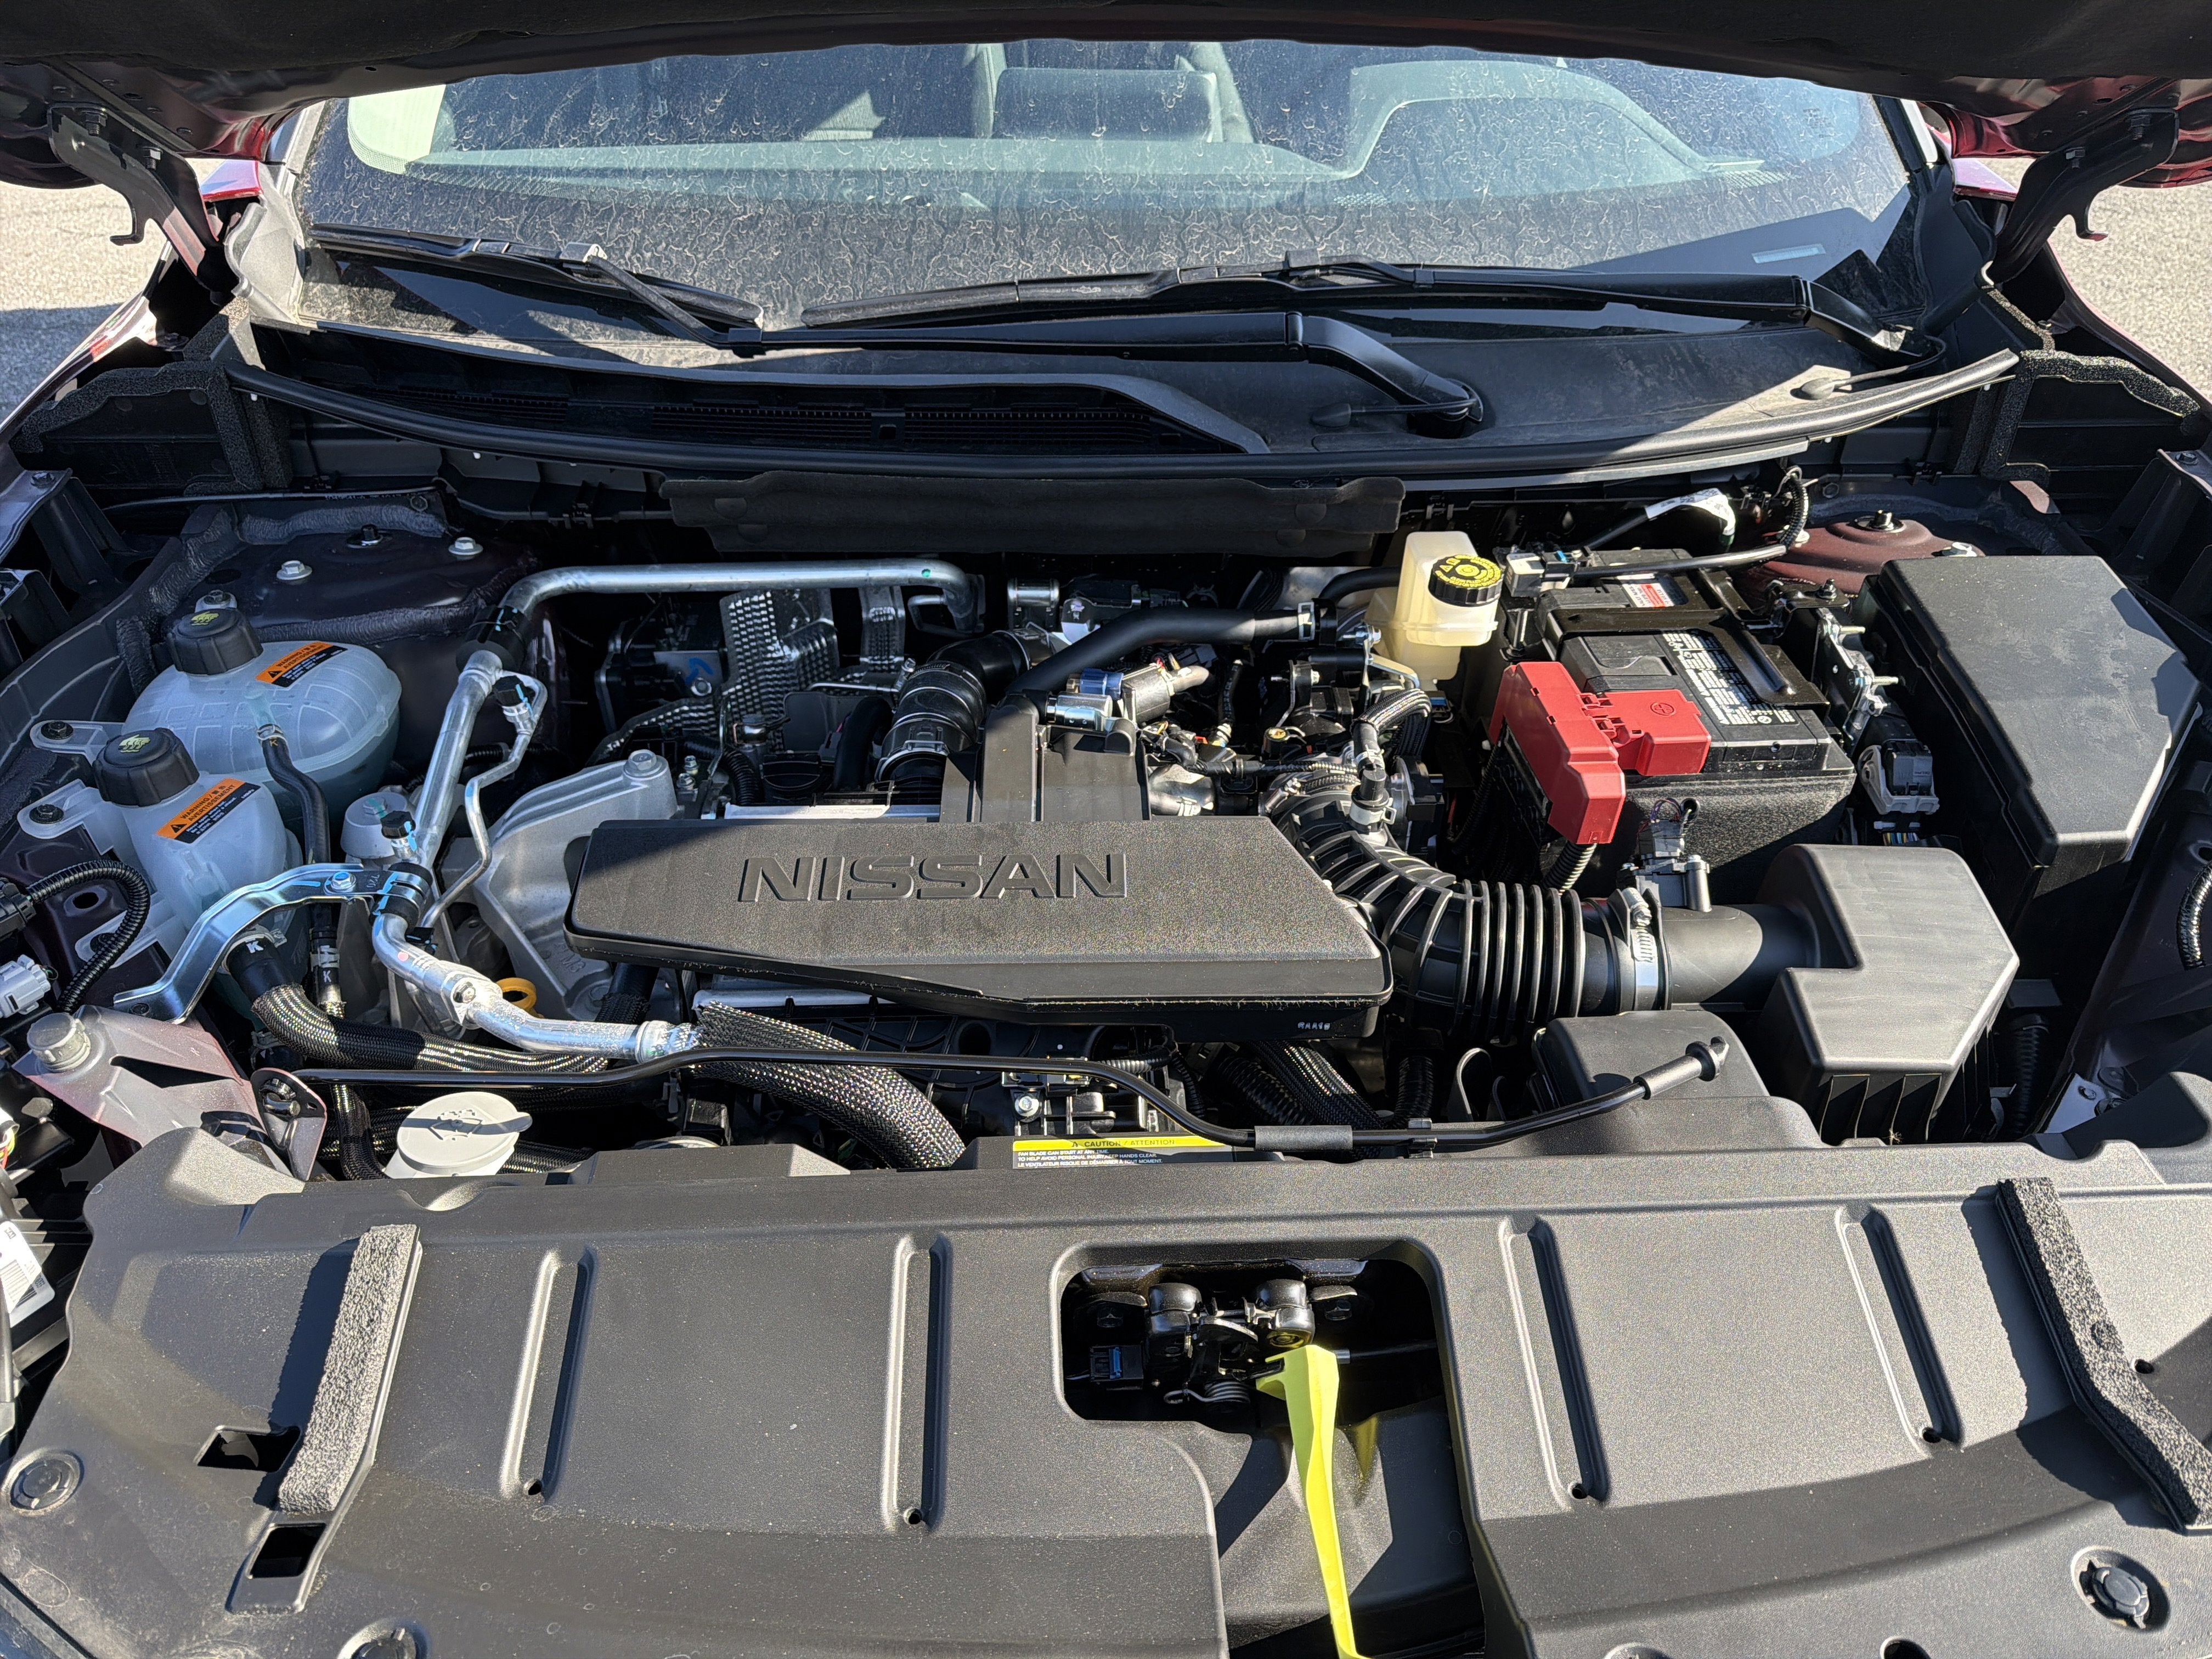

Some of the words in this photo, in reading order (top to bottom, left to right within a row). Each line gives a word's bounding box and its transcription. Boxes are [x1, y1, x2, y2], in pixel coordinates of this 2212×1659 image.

[180, 797, 210, 819] WARNING
[188, 784, 236, 821] AVERTISSEMENT
[738, 854, 1127, 902] NISSAN
[246, 940, 264, 953] K
[323, 970, 332, 983] K
